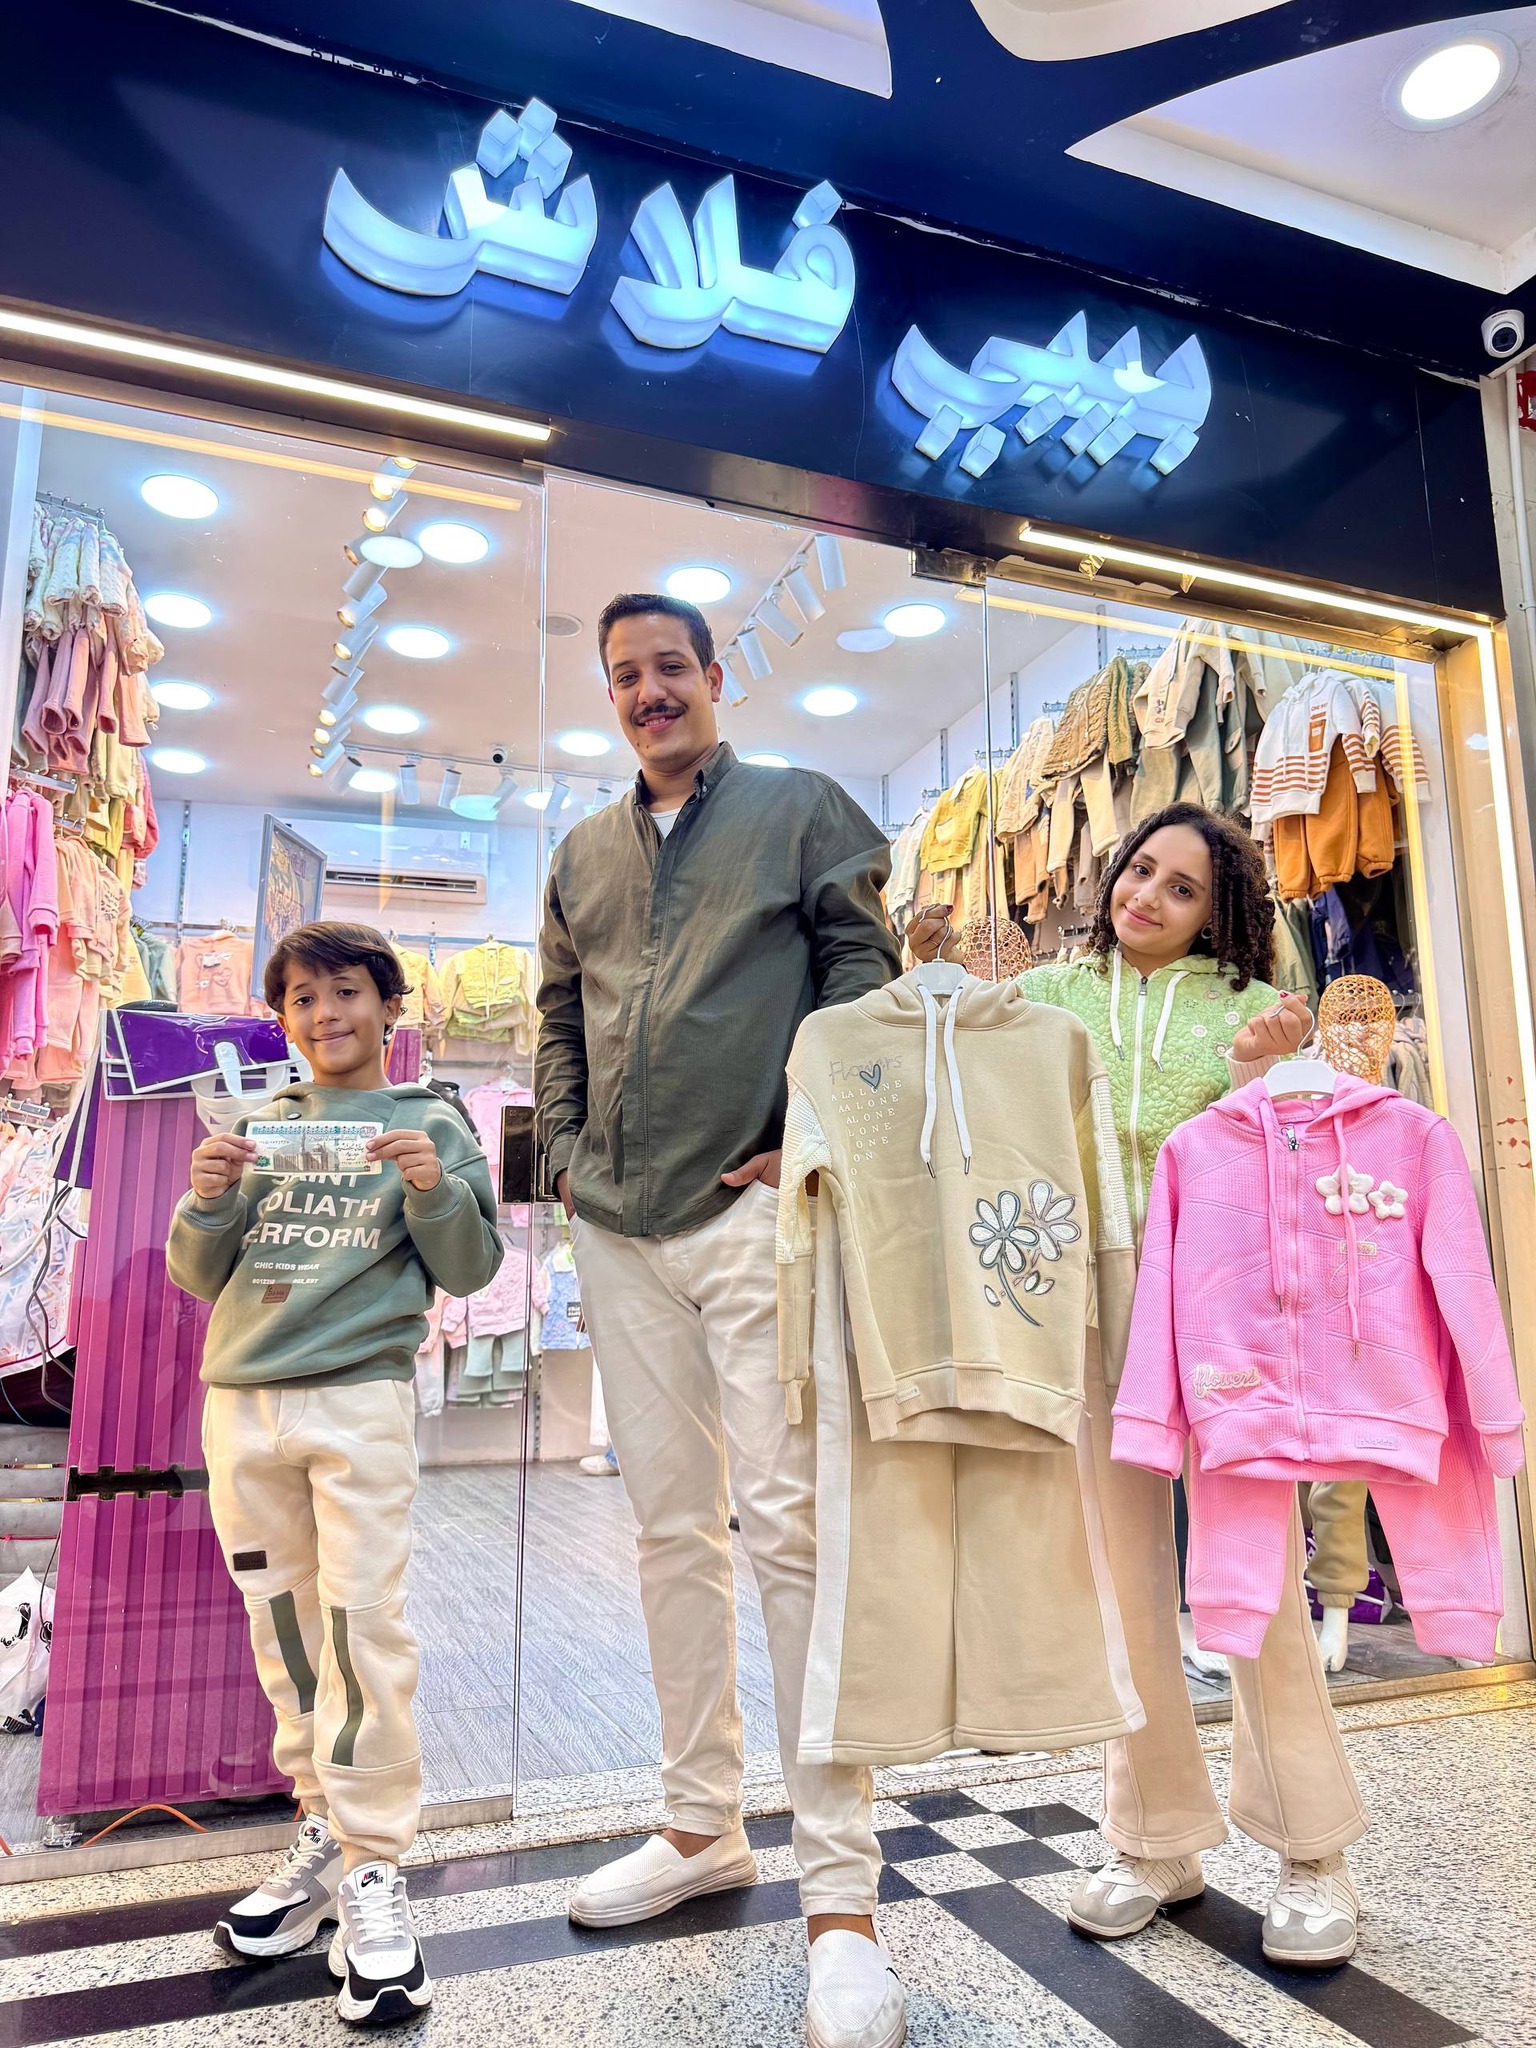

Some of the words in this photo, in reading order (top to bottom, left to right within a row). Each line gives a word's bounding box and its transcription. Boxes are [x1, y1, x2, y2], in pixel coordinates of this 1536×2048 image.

[254, 1261, 274, 1269] CHIC
[275, 1262, 296, 1271] KIDS
[297, 1263, 321, 1271] WEAR
[1194, 1363, 1261, 1398] flowers
[363, 1869, 379, 1880] NIKE
[373, 1875, 384, 1885] AIR
